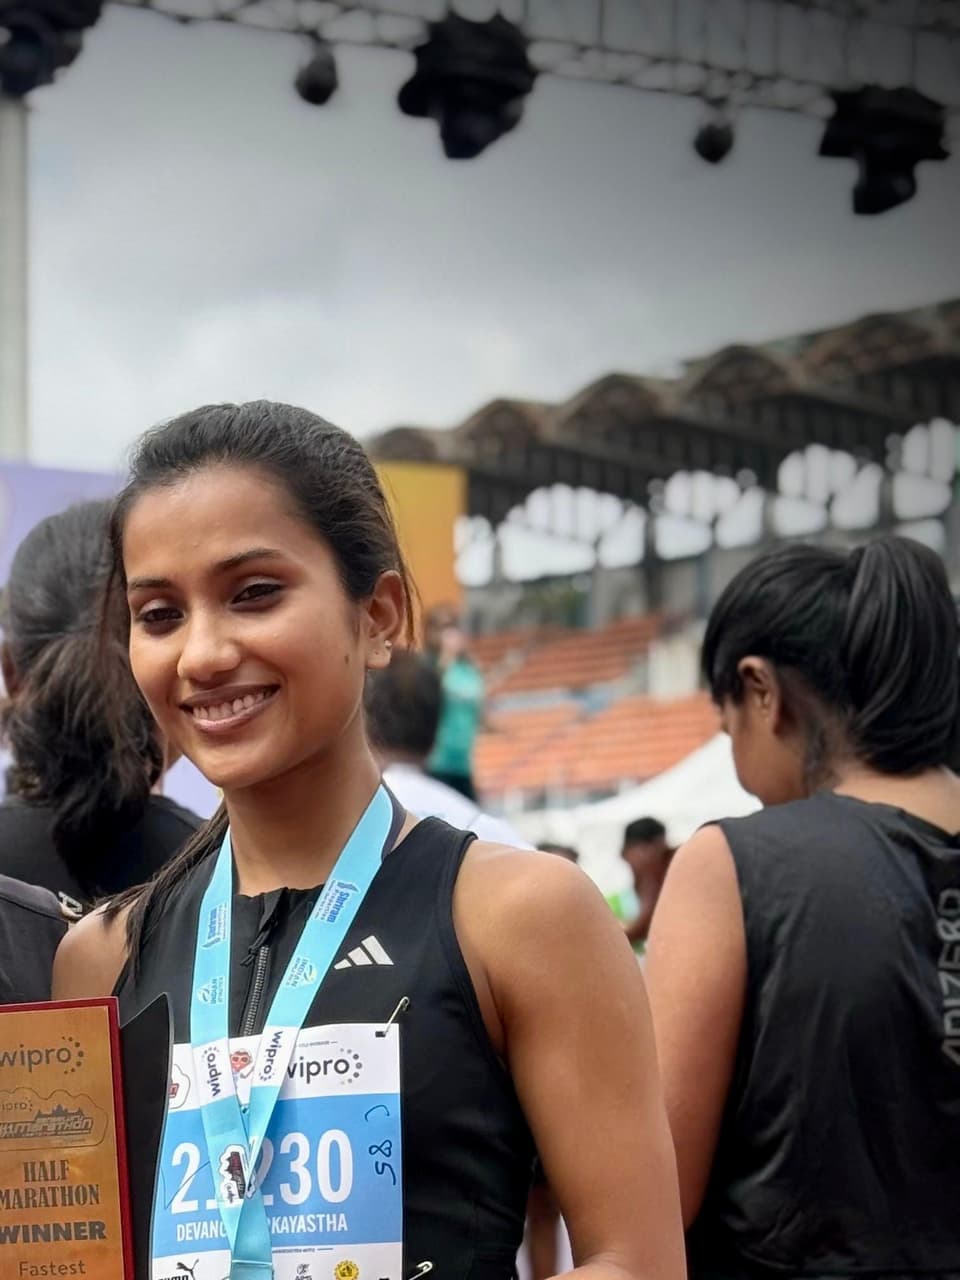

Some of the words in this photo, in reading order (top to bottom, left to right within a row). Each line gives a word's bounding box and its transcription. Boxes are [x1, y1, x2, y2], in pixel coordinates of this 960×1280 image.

[327, 891, 350, 923] Shriram
[263, 1031, 284, 1075] wipro
[207, 1053, 222, 1097] wipro
[23, 1159, 69, 1182] HALF
[171, 1129, 353, 1214] 2230
[19, 1260, 86, 1277] Fastest
